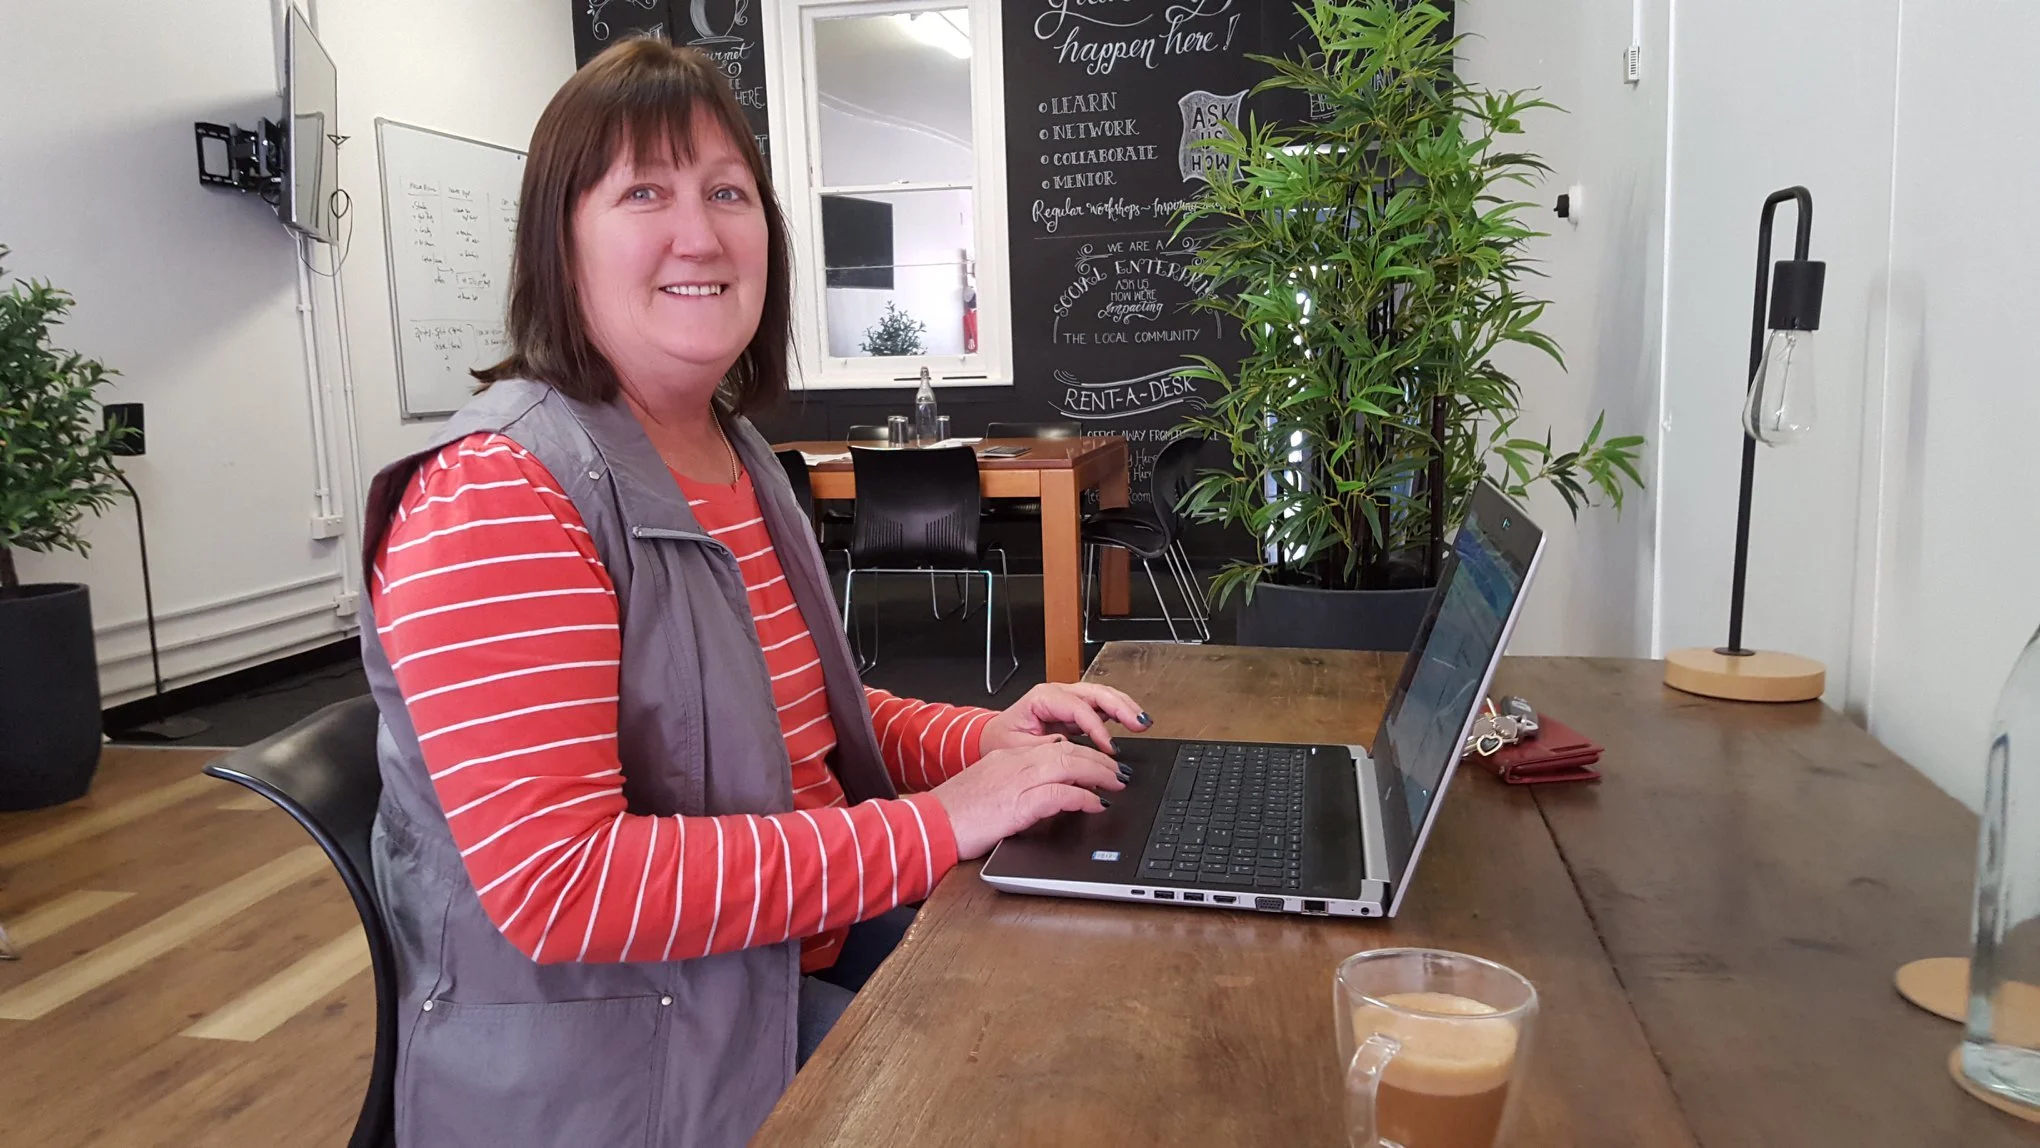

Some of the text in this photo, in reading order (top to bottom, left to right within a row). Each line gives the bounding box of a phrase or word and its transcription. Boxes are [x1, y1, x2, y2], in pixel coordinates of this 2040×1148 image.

[1054, 26, 1159, 75] happen
[1051, 92, 1118, 115] LEARN
[1193, 103, 1233, 129] ASK
[1053, 118, 1140, 140] NETWORK
[1053, 145, 1159, 166] COLLABORATE
[1192, 154, 1230, 171] HOW
[1053, 170, 1117, 190] MENTOR
[1032, 197, 1085, 234] Regular
[1107, 239, 1165, 253] WE ARE A
[1053, 267, 1107, 317] SOCIAL
[1115, 278, 1149, 291] ASK US
[1110, 291, 1132, 302] HOW
[1098, 300, 1163, 323] Impacting
[1063, 328, 1201, 345] THE LOCAL COMMUNITY
